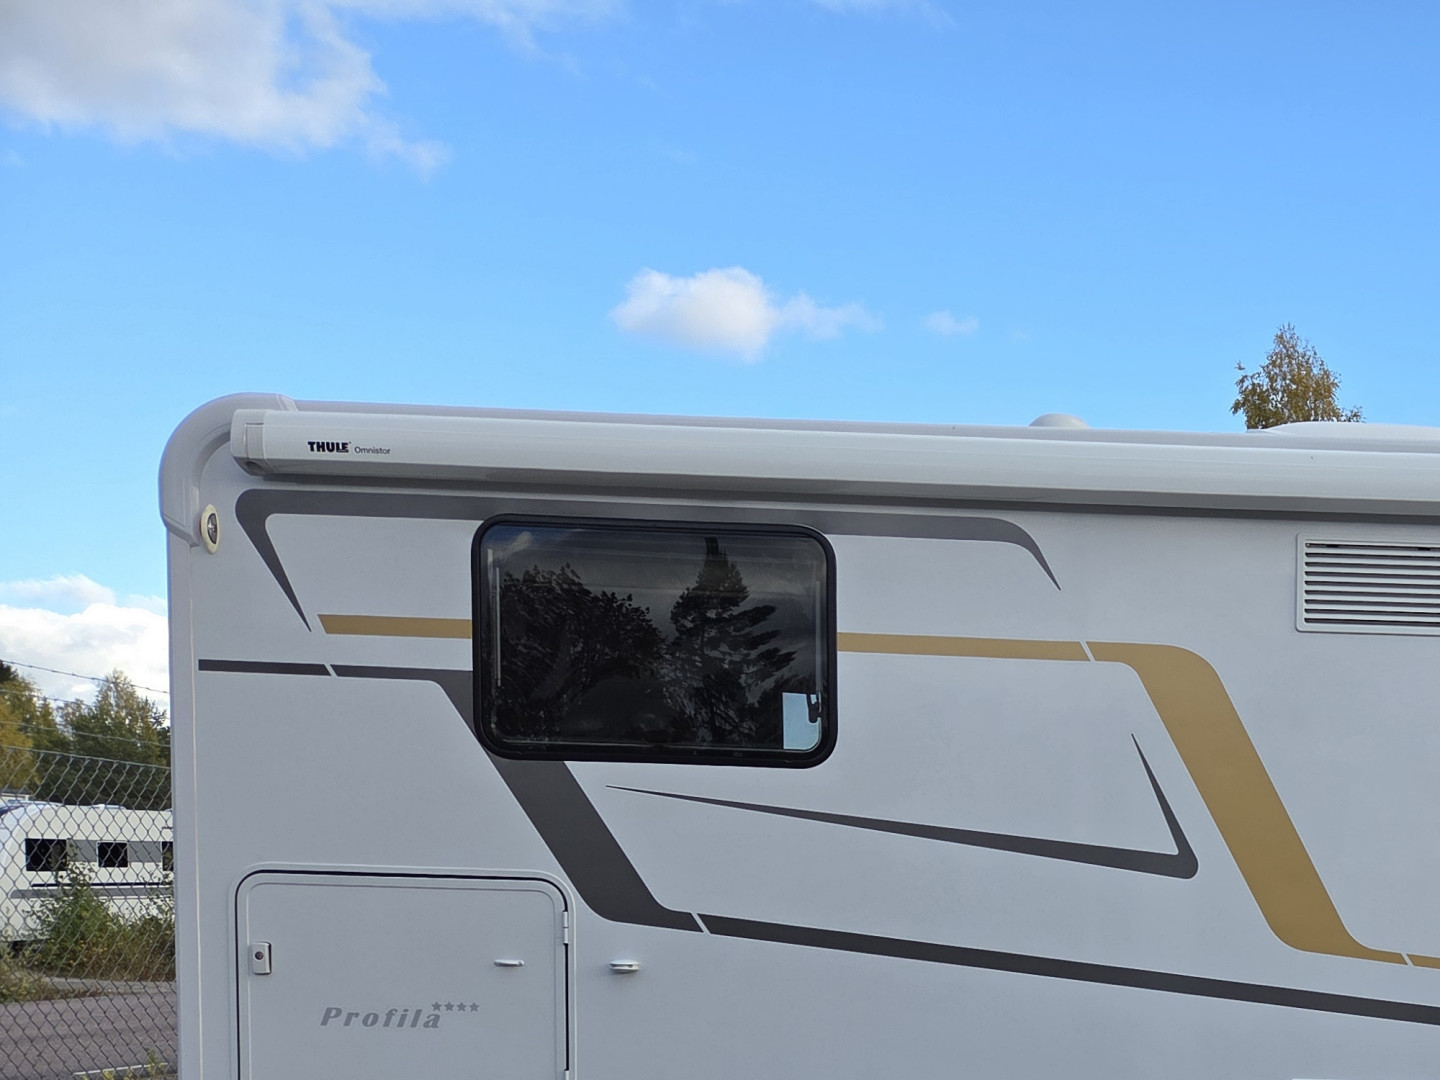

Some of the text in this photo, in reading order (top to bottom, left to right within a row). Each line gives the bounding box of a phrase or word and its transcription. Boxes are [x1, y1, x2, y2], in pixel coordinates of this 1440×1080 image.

[308, 441, 391, 455] THULE Omnistor
[320, 1007, 441, 1029] Profila
